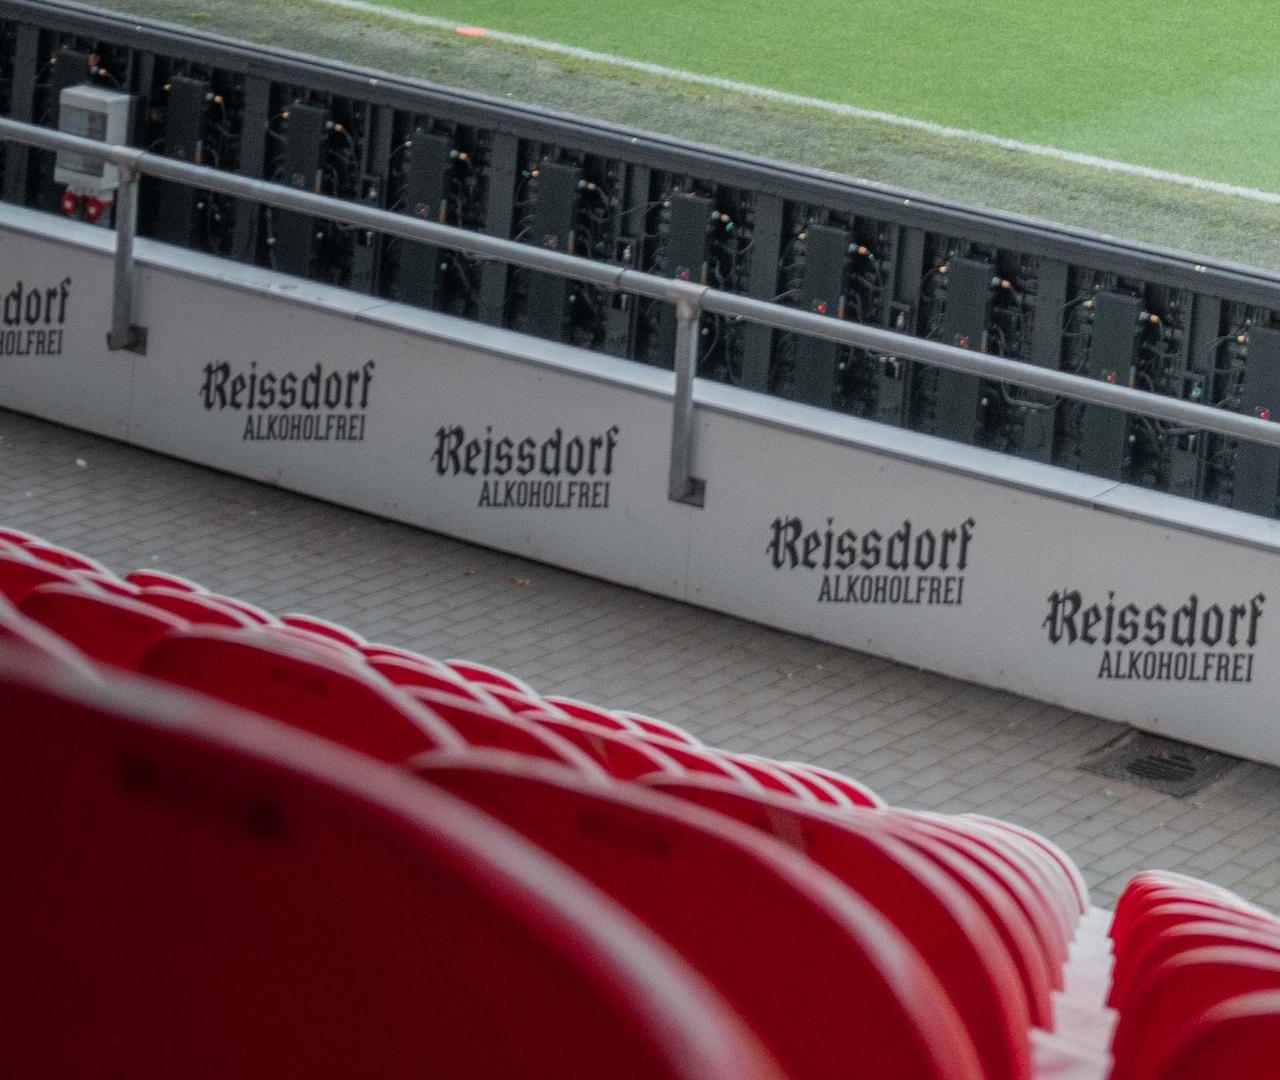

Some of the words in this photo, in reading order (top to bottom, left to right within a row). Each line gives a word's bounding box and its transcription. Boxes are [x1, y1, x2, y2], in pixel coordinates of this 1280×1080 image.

[199, 360, 375, 411] Reissdorf
[243, 414, 365, 441] ALKOHOLFREI
[433, 425, 619, 477] Reissdorf
[478, 480, 610, 509] ALKOHOLFREI
[766, 517, 976, 572] Reissdorf
[818, 575, 964, 605] ALKOHOLFREI
[1042, 590, 1266, 648] Reissdorf
[1098, 650, 1254, 683] ALKOHOLFREI
